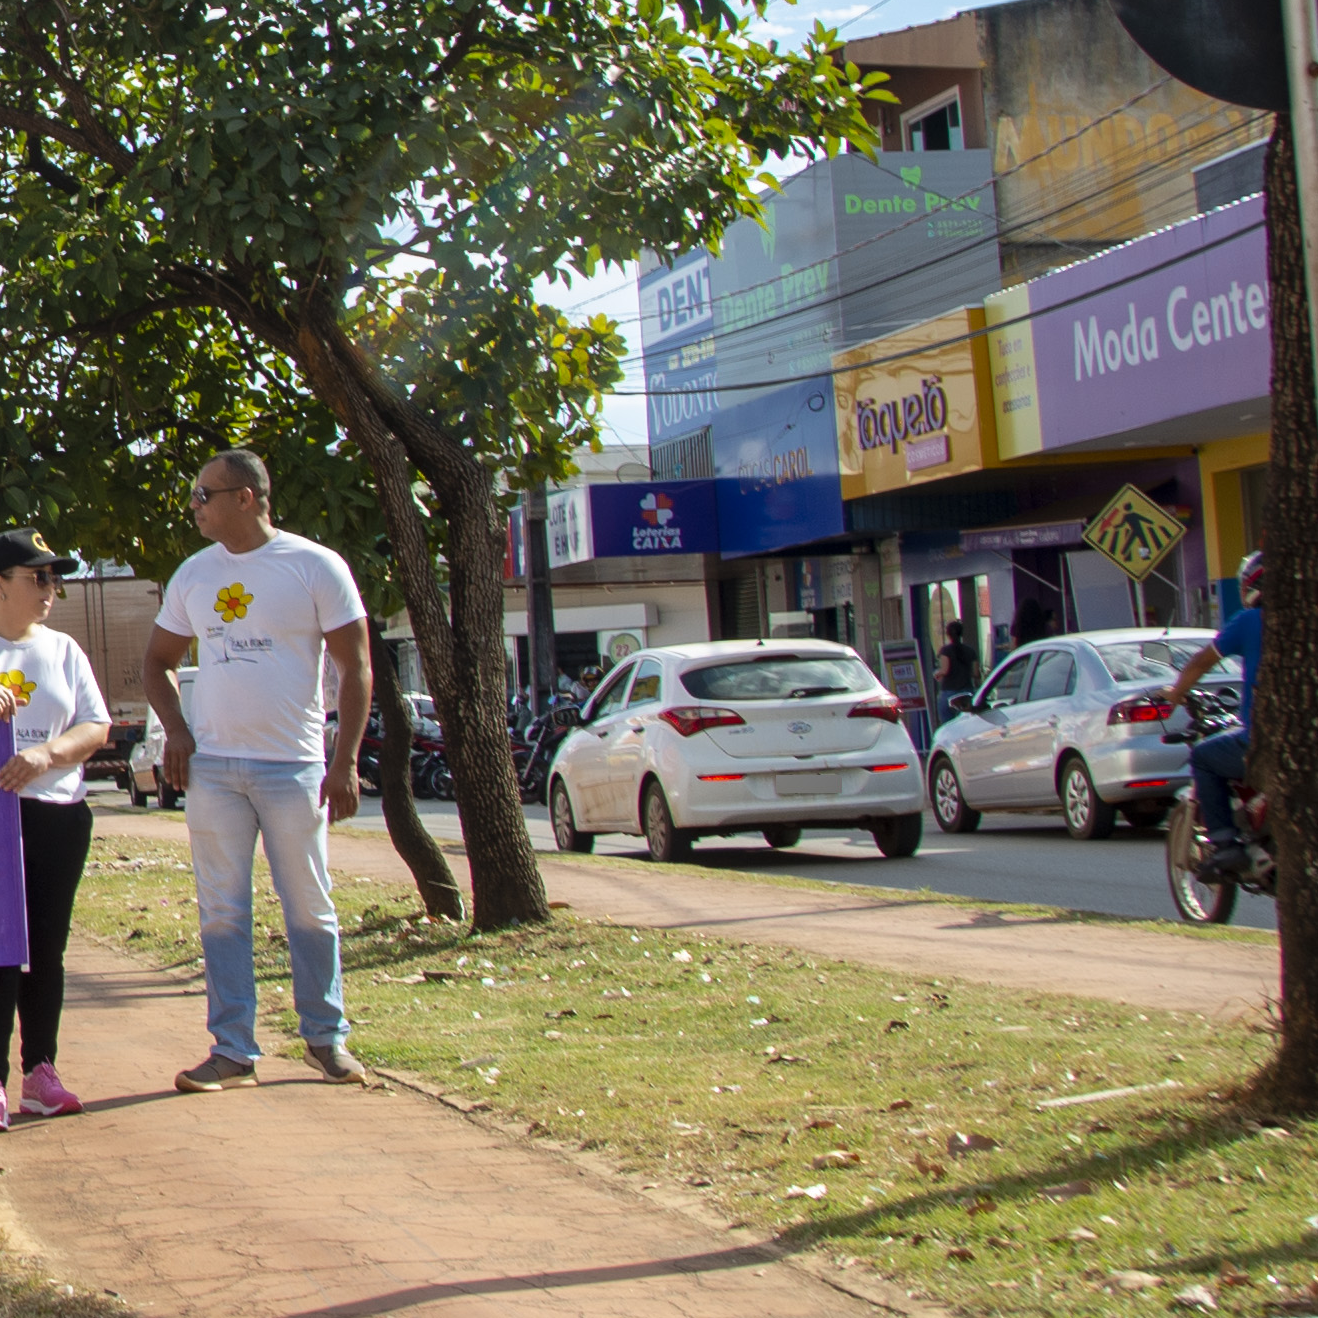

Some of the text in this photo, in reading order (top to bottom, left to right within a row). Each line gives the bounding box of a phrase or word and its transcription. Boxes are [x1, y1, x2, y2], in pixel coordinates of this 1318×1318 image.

[844, 192, 981, 214] Dente Prev
[720, 262, 829, 334] Dente Prev
[1074, 303, 1160, 382] Moda
[774, 446, 814, 485] CAROL
[632, 526, 680, 537] Loterias
[632, 537, 683, 550] CAIXA
